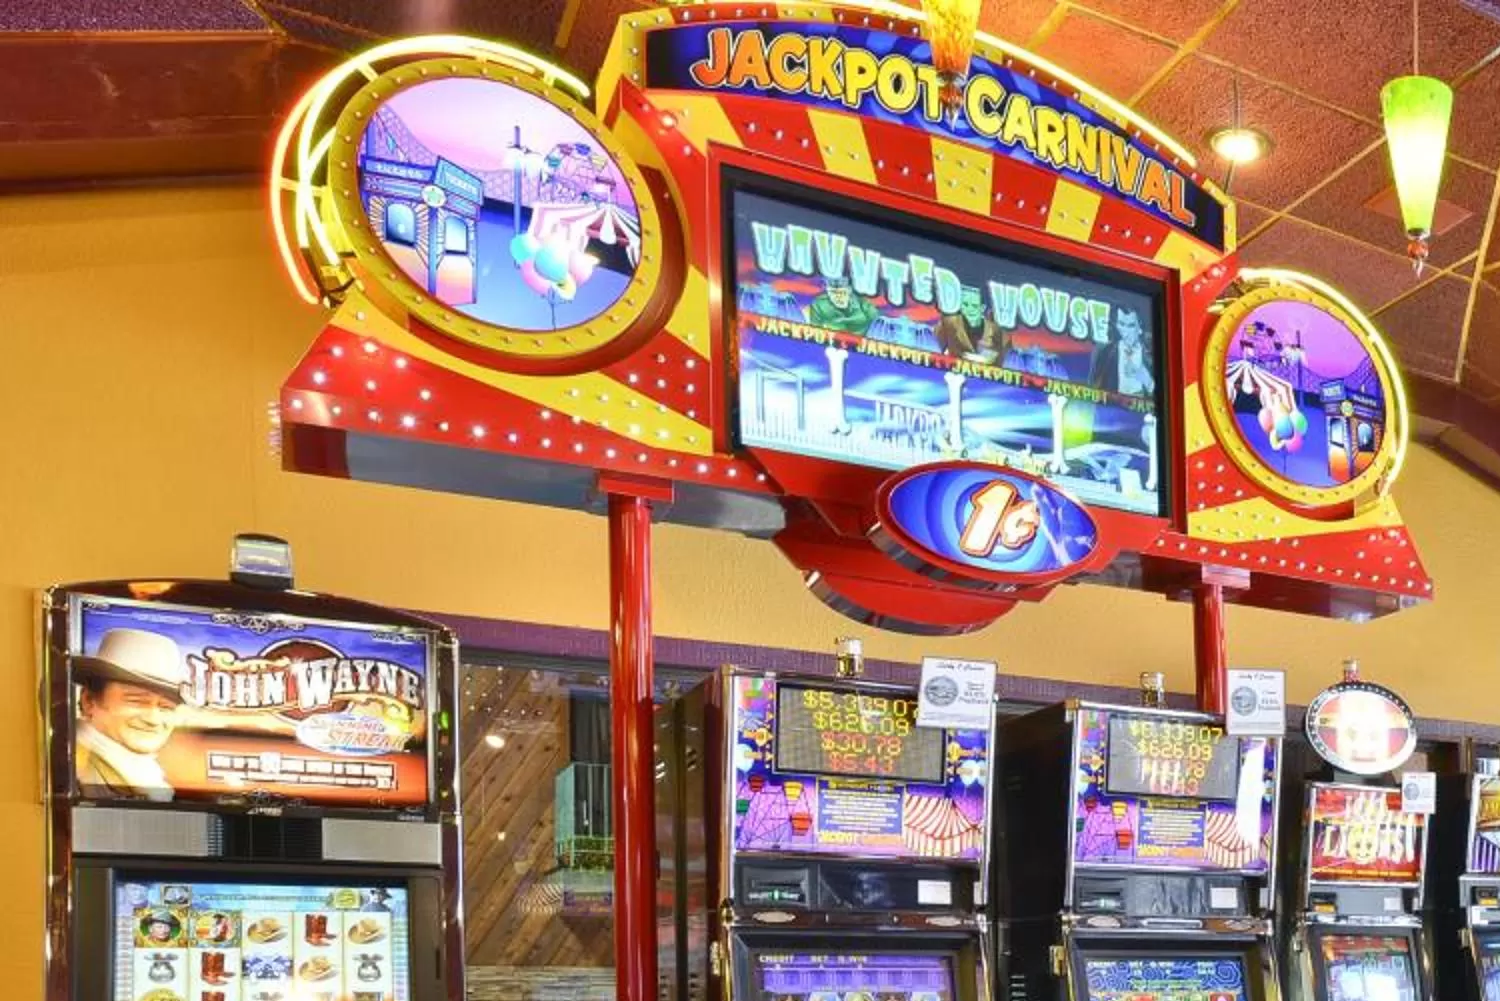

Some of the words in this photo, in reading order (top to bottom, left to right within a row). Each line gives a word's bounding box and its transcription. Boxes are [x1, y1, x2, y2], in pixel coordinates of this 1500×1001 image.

[690, 28, 944, 121] JACKPOT
[963, 74, 1197, 228] CARNIVAL
[752, 221, 962, 314] HAUNTED
[989, 281, 1111, 343] HOUSE
[959, 480, 1040, 556] 1¢
[179, 653, 286, 709] JOHN
[293, 657, 423, 709] WAYNE
[813, 711, 909, 737] $626.09
